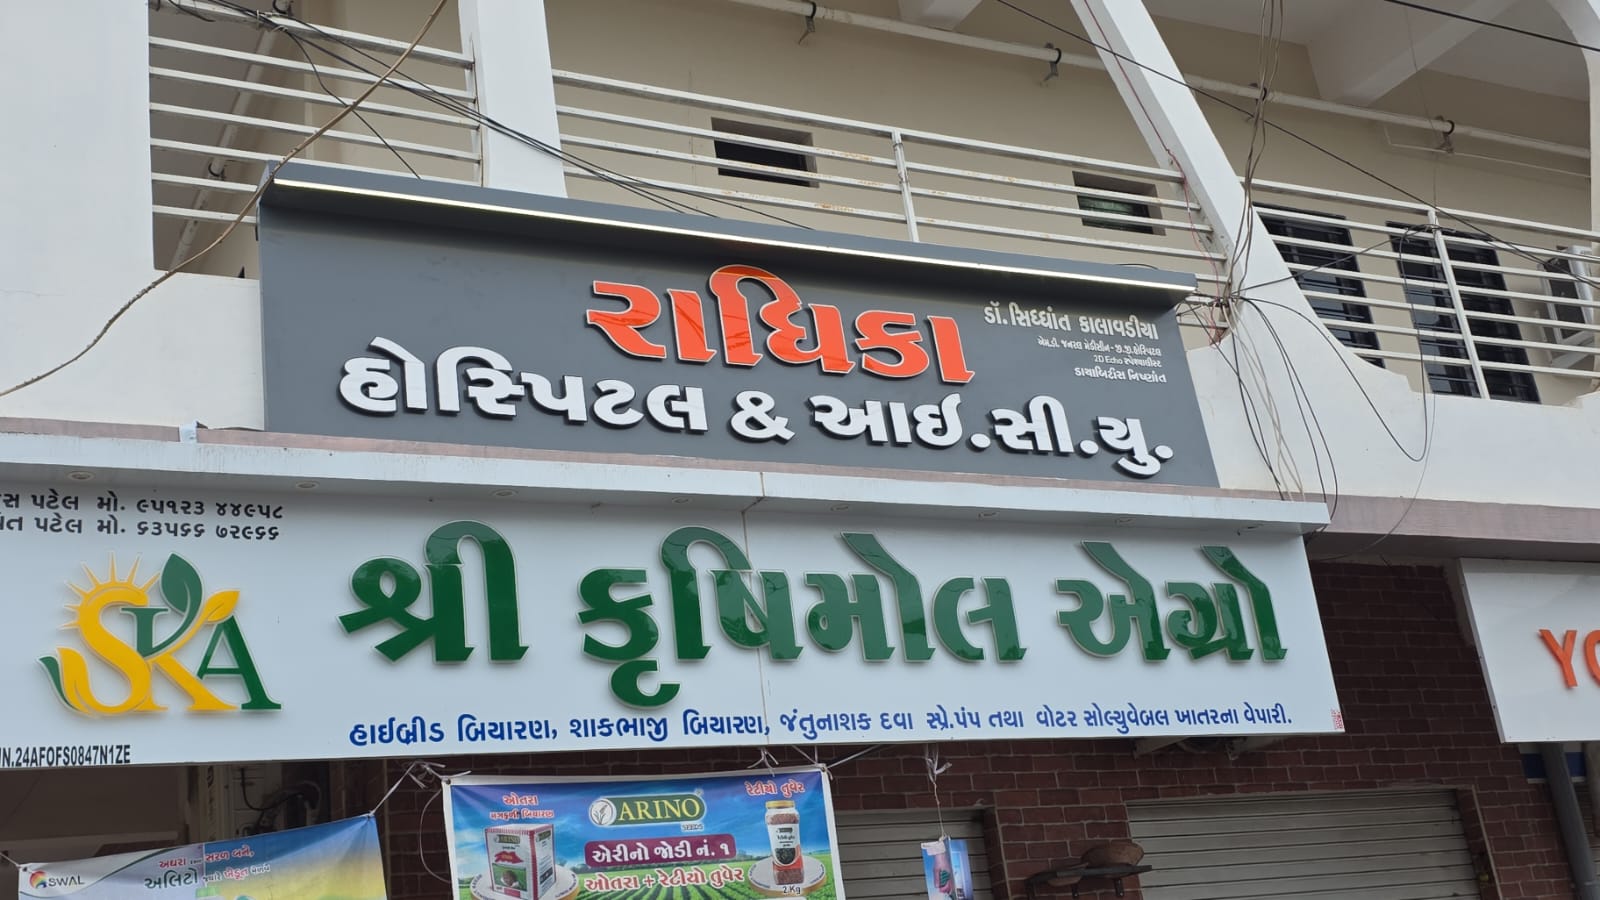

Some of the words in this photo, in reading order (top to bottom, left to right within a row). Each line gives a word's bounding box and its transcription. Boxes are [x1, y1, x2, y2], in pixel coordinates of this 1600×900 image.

[586, 263, 975, 383] રાધિકા
[1079, 314, 1159, 340] કાલાવડીયા
[1093, 354, 1104, 363] 2D
[1104, 355, 1123, 365] Echo
[338, 336, 710, 433] હોસ્પિટલ
[730, 390, 796, 442] &
[0, 493, 20, 509] સ
[31, 488, 79, 511] પટેલ
[97, 490, 126, 512] મો.
[136, 499, 205, 516] ૯૫૧૨૩
[215, 502, 283, 519] ૪૪૯૫૮
[34, 512, 83, 535] પટેલ
[97, 514, 126, 535] મો.
[137, 521, 206, 538] ૬૩૫૬૬
[215, 525, 280, 540] ૭૨૯૬૬
[338, 519, 530, 664] શ્રી
[576, 525, 1027, 709] કૃષિમોલ
[1055, 540, 1288, 662] એગ્રો
[54, 553, 282, 716] SKA
[457, 714, 558, 743] બિયારણ,
[569, 715, 668, 742] શાકભાજી
[683, 708, 770, 737] બિયારણ,
[780, 708, 872, 741] જંતુનાશક
[880, 712, 914, 731] દવા
[989, 709, 1025, 729] તથા
[1036, 704, 1078, 728] વોટર
[1083, 702, 1170, 735] સોલ્યુવેબલ
[1175, 708, 1240, 726] ખાતરના
[1244, 702, 1293, 725] વેપારી.
[502, 791, 538, 806] ઓતરા
[618, 797, 701, 821] ARINO
[592, 842, 650, 863] એરીનો
[654, 839, 693, 859] જોડી
[696, 838, 715, 857] નં.
[720, 842, 730, 856] ૧
[48, 873, 85, 887] SWAL
[144, 867, 198, 889] અલિટો
[584, 872, 640, 892] ઓતરા
[643, 875, 655, 888] +
[656, 865, 707, 888] રેટીયો
[709, 864, 745, 888] તુવેર
